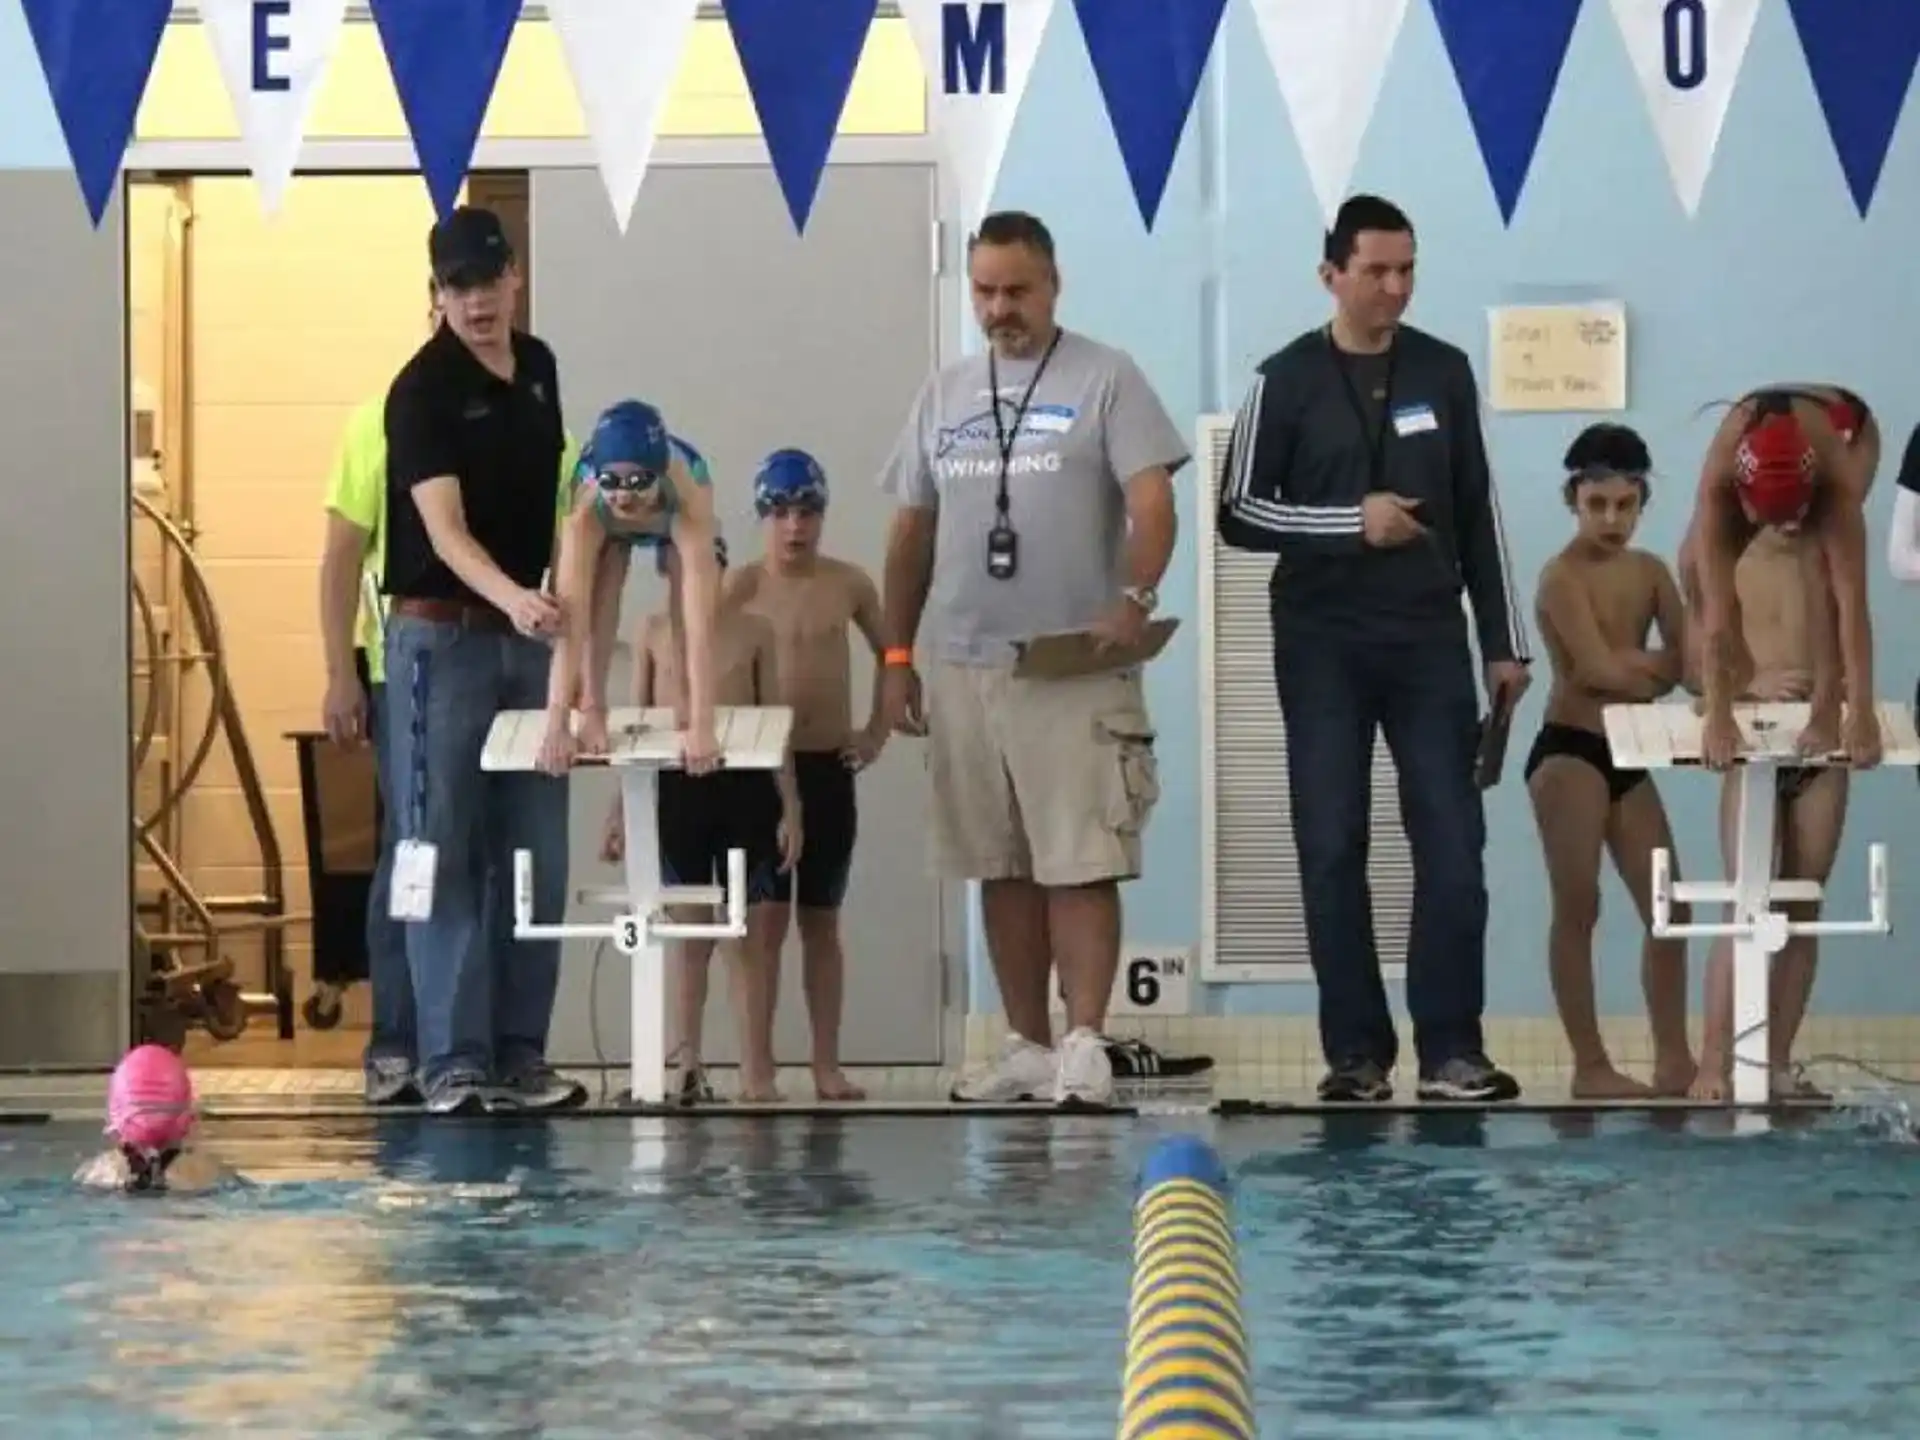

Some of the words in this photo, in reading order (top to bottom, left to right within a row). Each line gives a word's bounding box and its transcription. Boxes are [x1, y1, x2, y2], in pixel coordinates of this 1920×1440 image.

[252, 2, 290, 91] E
[942, 3, 1006, 94] M
[624, 921, 638, 948] 3
[1128, 957, 1160, 1007] 6
[1162, 957, 1185, 976] IN
